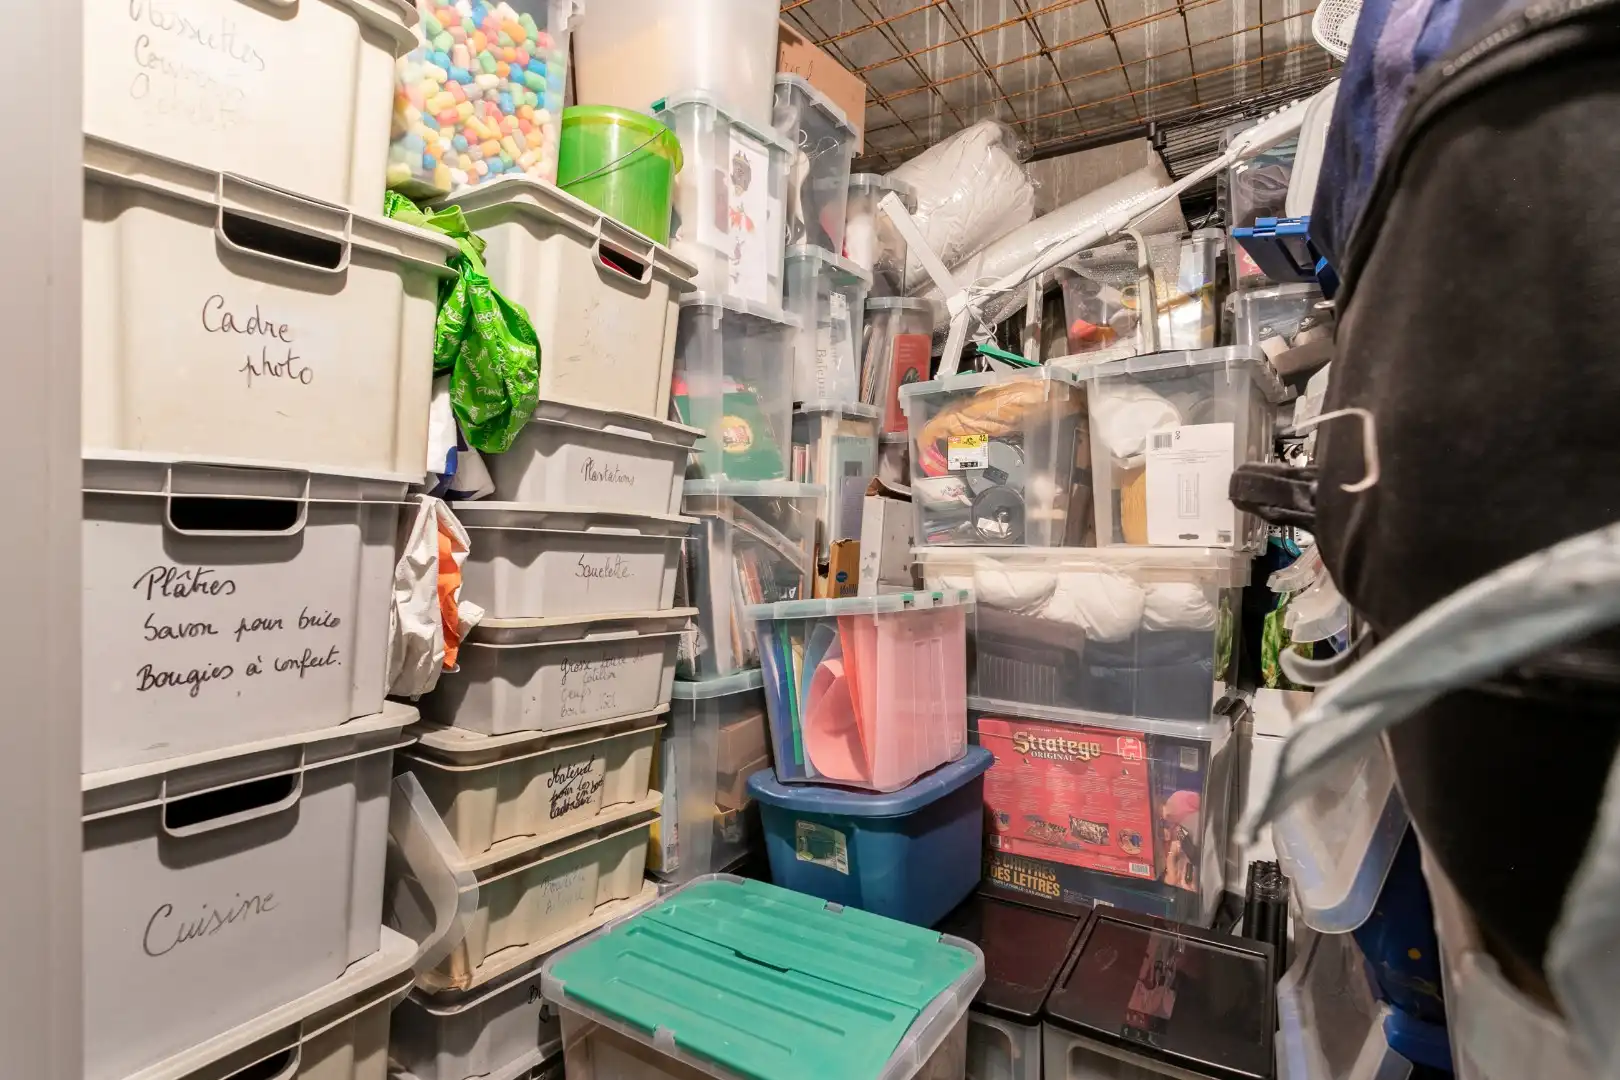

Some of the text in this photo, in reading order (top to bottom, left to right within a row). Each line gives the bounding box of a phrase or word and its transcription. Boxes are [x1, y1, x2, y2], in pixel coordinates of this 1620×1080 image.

[202, 294, 294, 343] Cadre
[238, 345, 313, 388] photo
[580, 456, 635, 488] Plantations
[132, 565, 237, 601] Plâtres
[143, 612, 219, 642] Savon
[233, 616, 284, 643] pour
[136, 663, 234, 698] Bougies
[245, 654, 263, 677] à
[1013, 731, 1101, 761] Stratego
[1031, 751, 1075, 762] ORIGINAL
[990, 865, 1011, 882] DES
[1013, 871, 1061, 897] LETTRES
[142, 892, 281, 957] Cuisine
